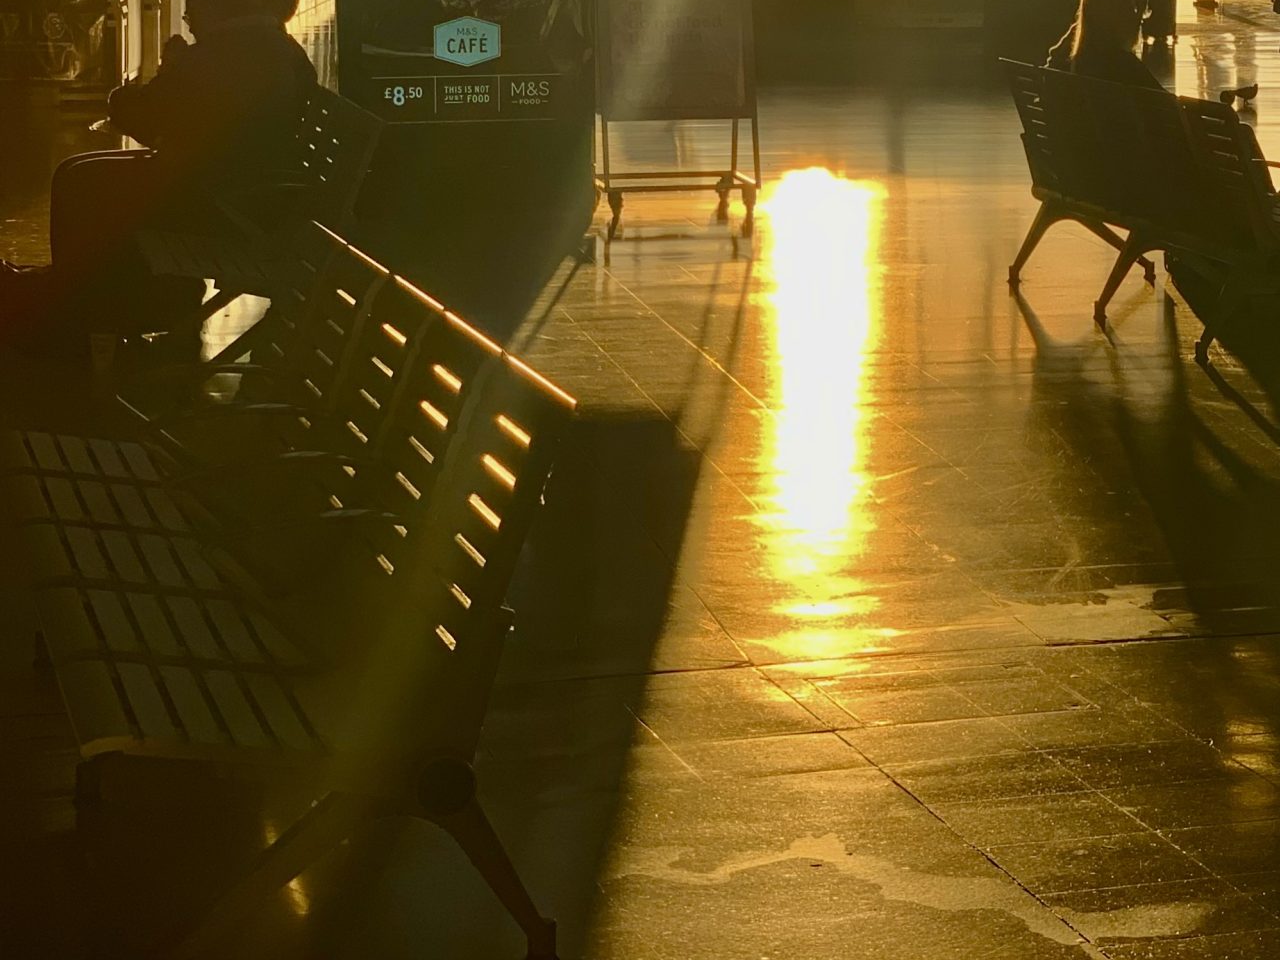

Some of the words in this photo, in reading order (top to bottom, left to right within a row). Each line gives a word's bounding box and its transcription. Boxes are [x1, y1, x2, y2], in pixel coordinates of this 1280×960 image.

[456, 27, 478, 37] M&S
[446, 33, 488, 54] CAFÉ
[444, 85, 463, 94] THIS
[464, 85, 472, 93] IS
[474, 85, 490, 93] NOT
[510, 81, 550, 97] M&S
[384, 86, 423, 106] £8.50
[444, 94, 464, 102] JUST
[467, 94, 490, 103] FOOD
